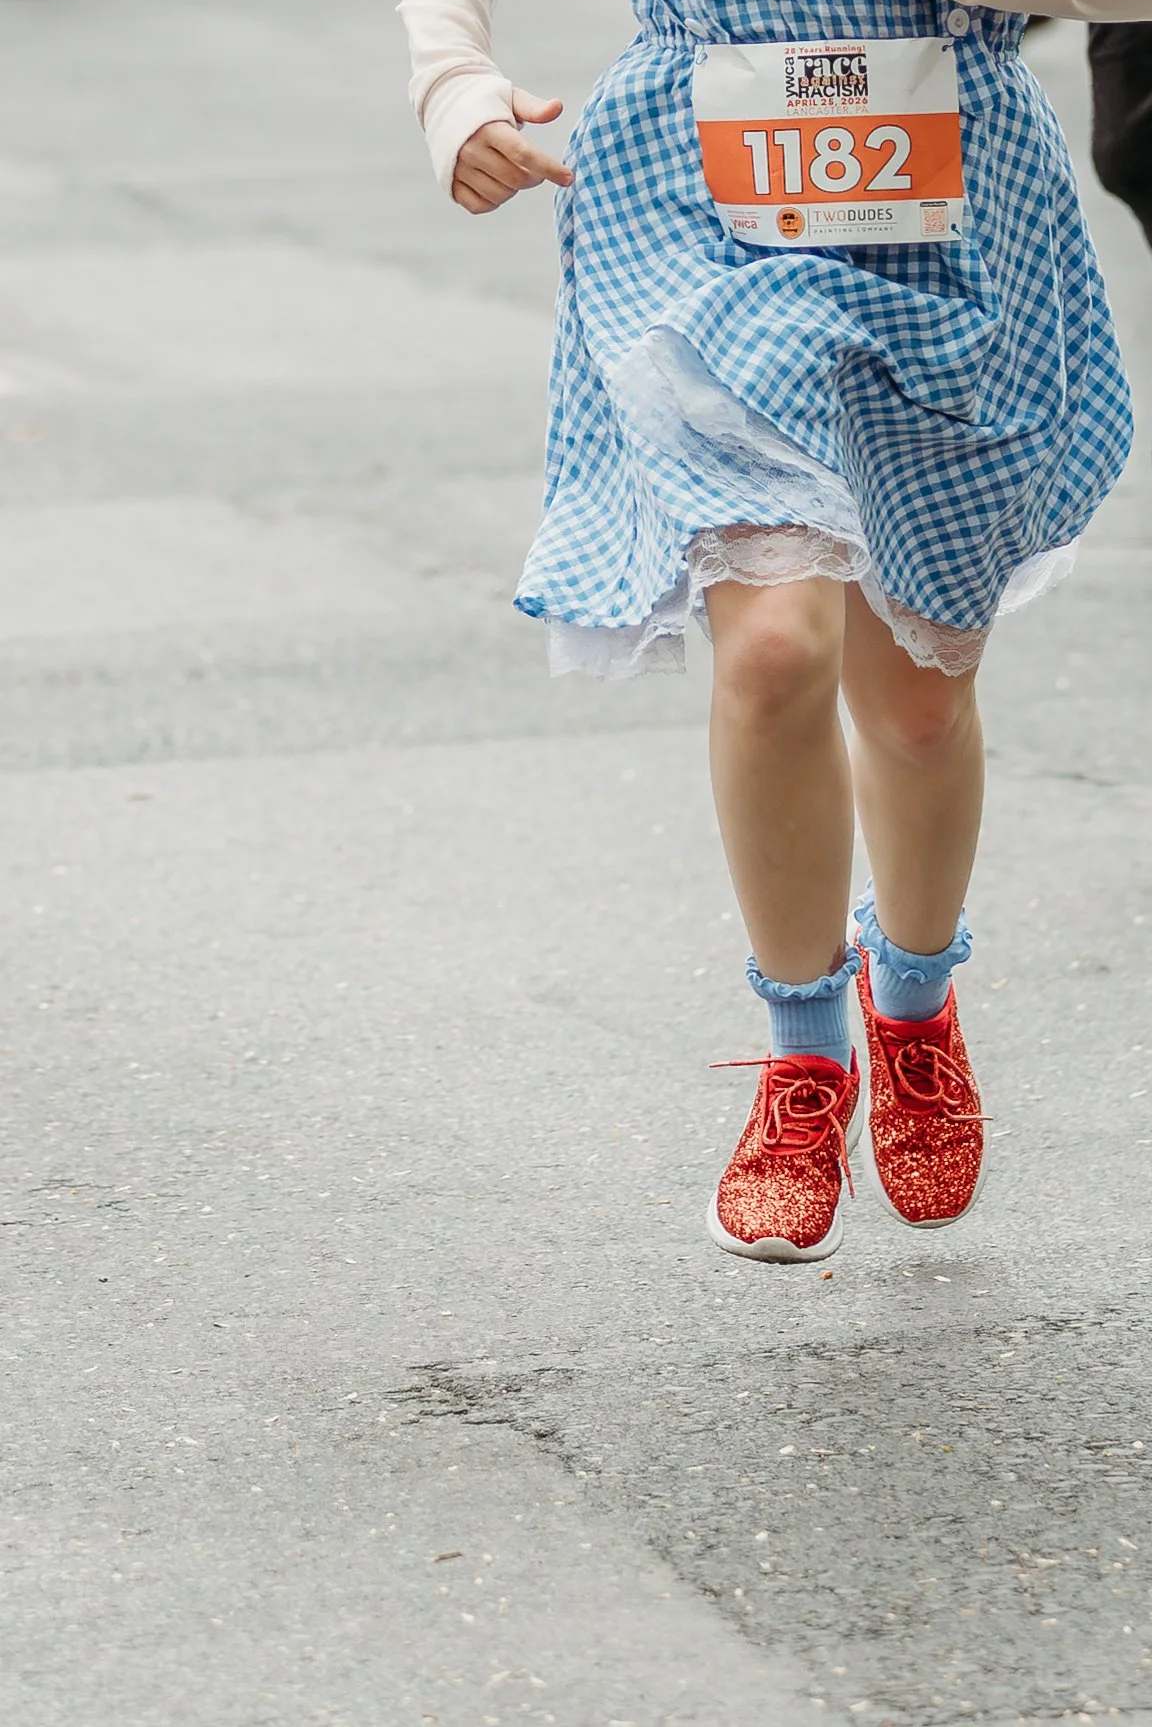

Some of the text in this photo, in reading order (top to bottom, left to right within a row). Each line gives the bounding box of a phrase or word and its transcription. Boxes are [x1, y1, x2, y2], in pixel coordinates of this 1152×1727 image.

[799, 46, 822, 54] Years
[825, 44, 866, 53] Running!
[798, 56, 867, 77] race
[785, 56, 798, 98] ywca
[800, 75, 866, 88] against
[798, 84, 868, 98] RACISM
[787, 99, 818, 107] APRIL
[742, 124, 912, 196] 1182
